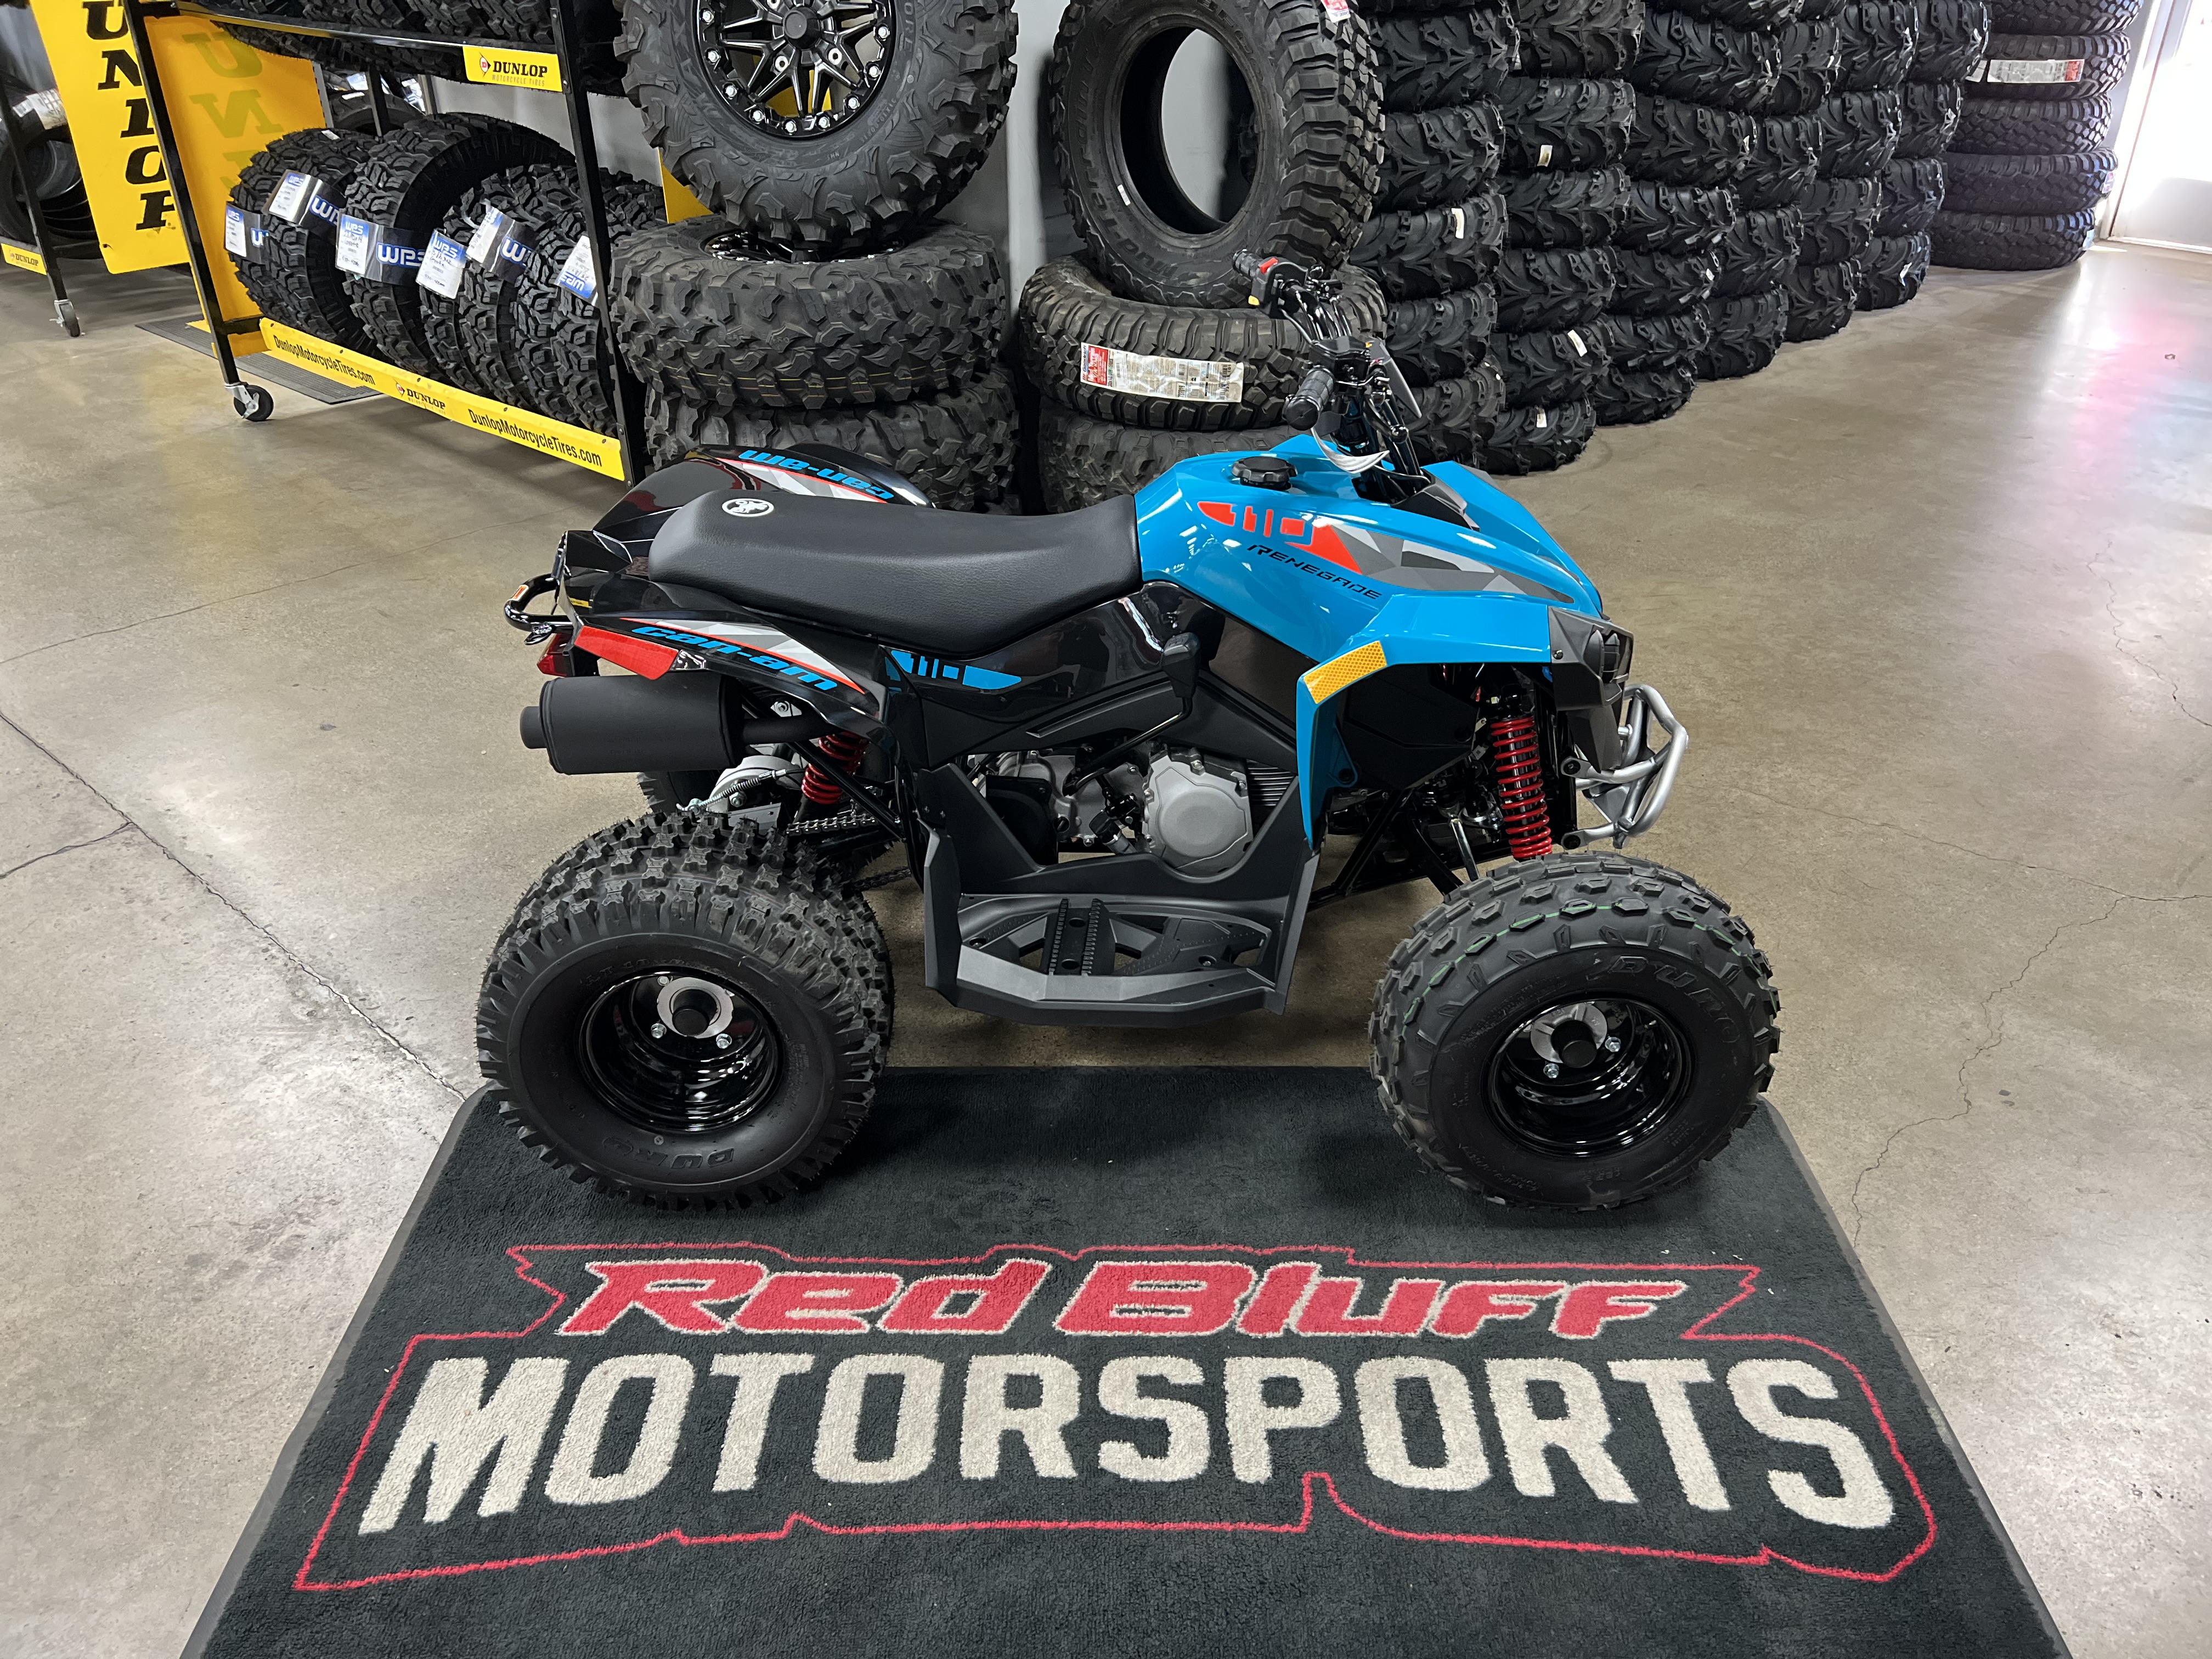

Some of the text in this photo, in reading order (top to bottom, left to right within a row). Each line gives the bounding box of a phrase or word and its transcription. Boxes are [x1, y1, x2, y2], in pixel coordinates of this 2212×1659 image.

[492, 74, 545, 87] MOTORCYCLE TIRES
[493, 61, 548, 78] DUNLOP
[345, 221, 364, 235] WPS
[434, 239, 458, 258] WPS
[15, 253, 38, 266] DUNLOP
[273, 335, 375, 385] DunlopMotorcycleTires.com
[407, 388, 445, 409] DUNLOP
[468, 409, 602, 467] DunlopMotorcycleTires.com
[738, 450, 894, 499] can-am
[1247, 544, 1383, 600] RENEGADE
[631, 627, 838, 690] can-am
[555, 1257, 1052, 1336] Red
[358, 1354, 1894, 1536] MOTORSPORTS
